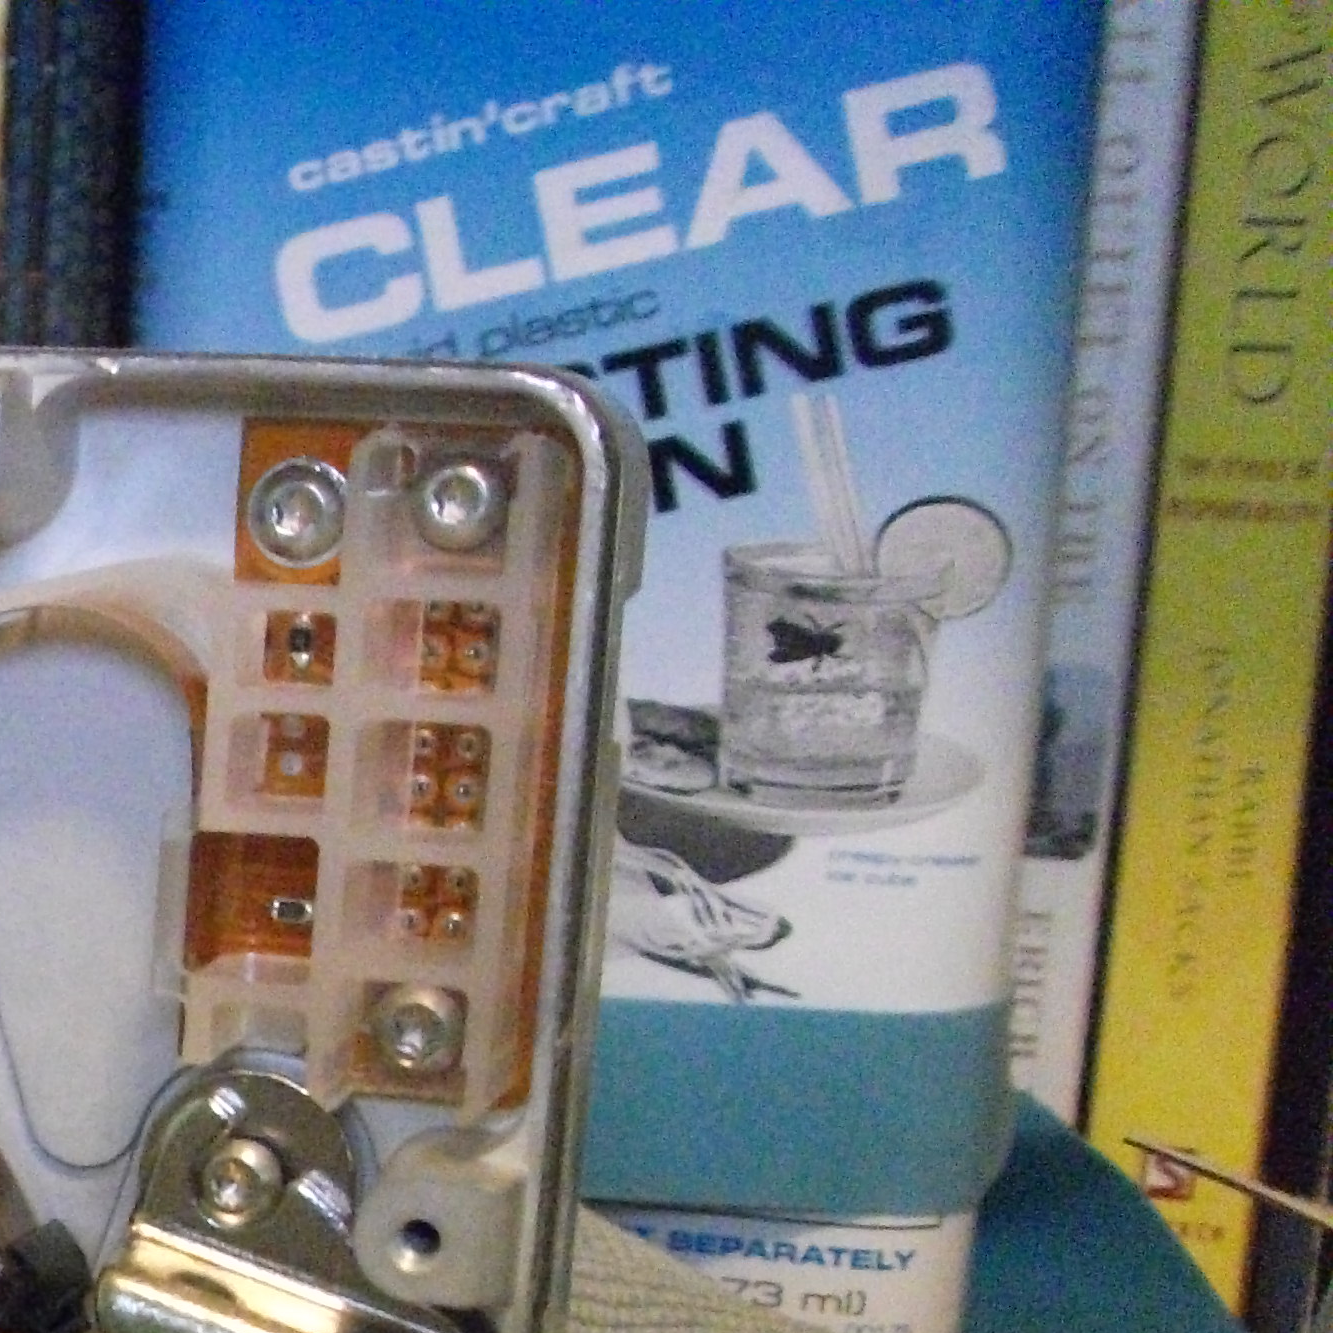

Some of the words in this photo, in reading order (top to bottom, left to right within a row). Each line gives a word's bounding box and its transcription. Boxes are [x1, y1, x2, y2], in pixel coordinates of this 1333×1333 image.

[286, 60, 674, 194] castin'craft
[273, 60, 1008, 345] CLEAR
[1228, 42, 1325, 406] WORLD
[474, 288, 662, 359] plastic
[560, 278, 956, 423] TING
[665, 1227, 918, 1273] SEPARATELY
